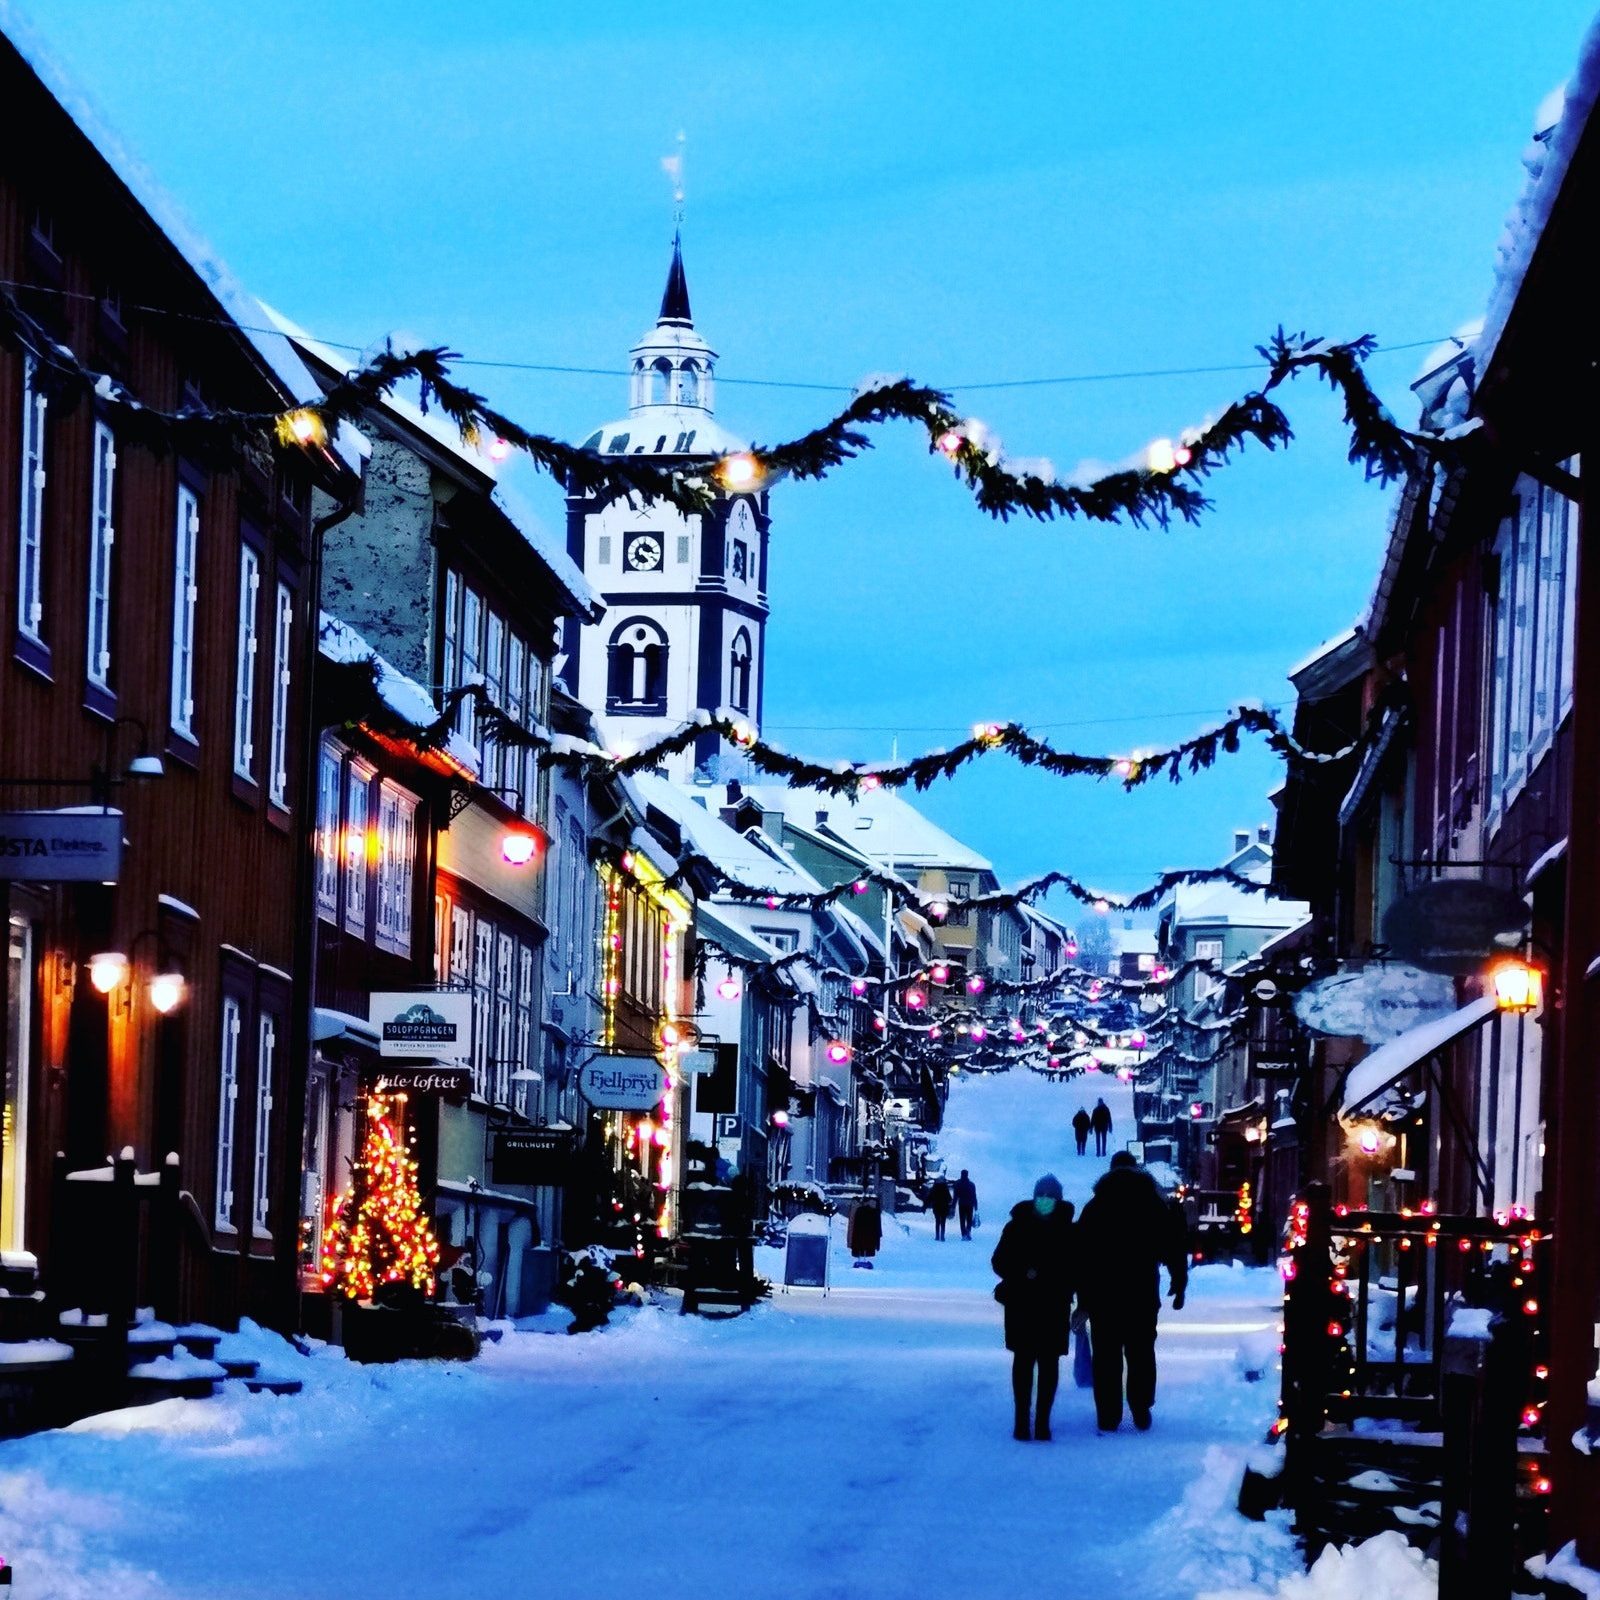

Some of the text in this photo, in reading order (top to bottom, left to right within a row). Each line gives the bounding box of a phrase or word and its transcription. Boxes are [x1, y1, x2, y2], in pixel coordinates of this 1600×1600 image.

[386, 1025, 454, 1035] SOLOPPGANGEN
[413, 1074, 460, 1092] loftet
[589, 1070, 657, 1093] Fjellpryd
[724, 1117, 737, 1135] P
[506, 1141, 556, 1149] GRILLHUSET
